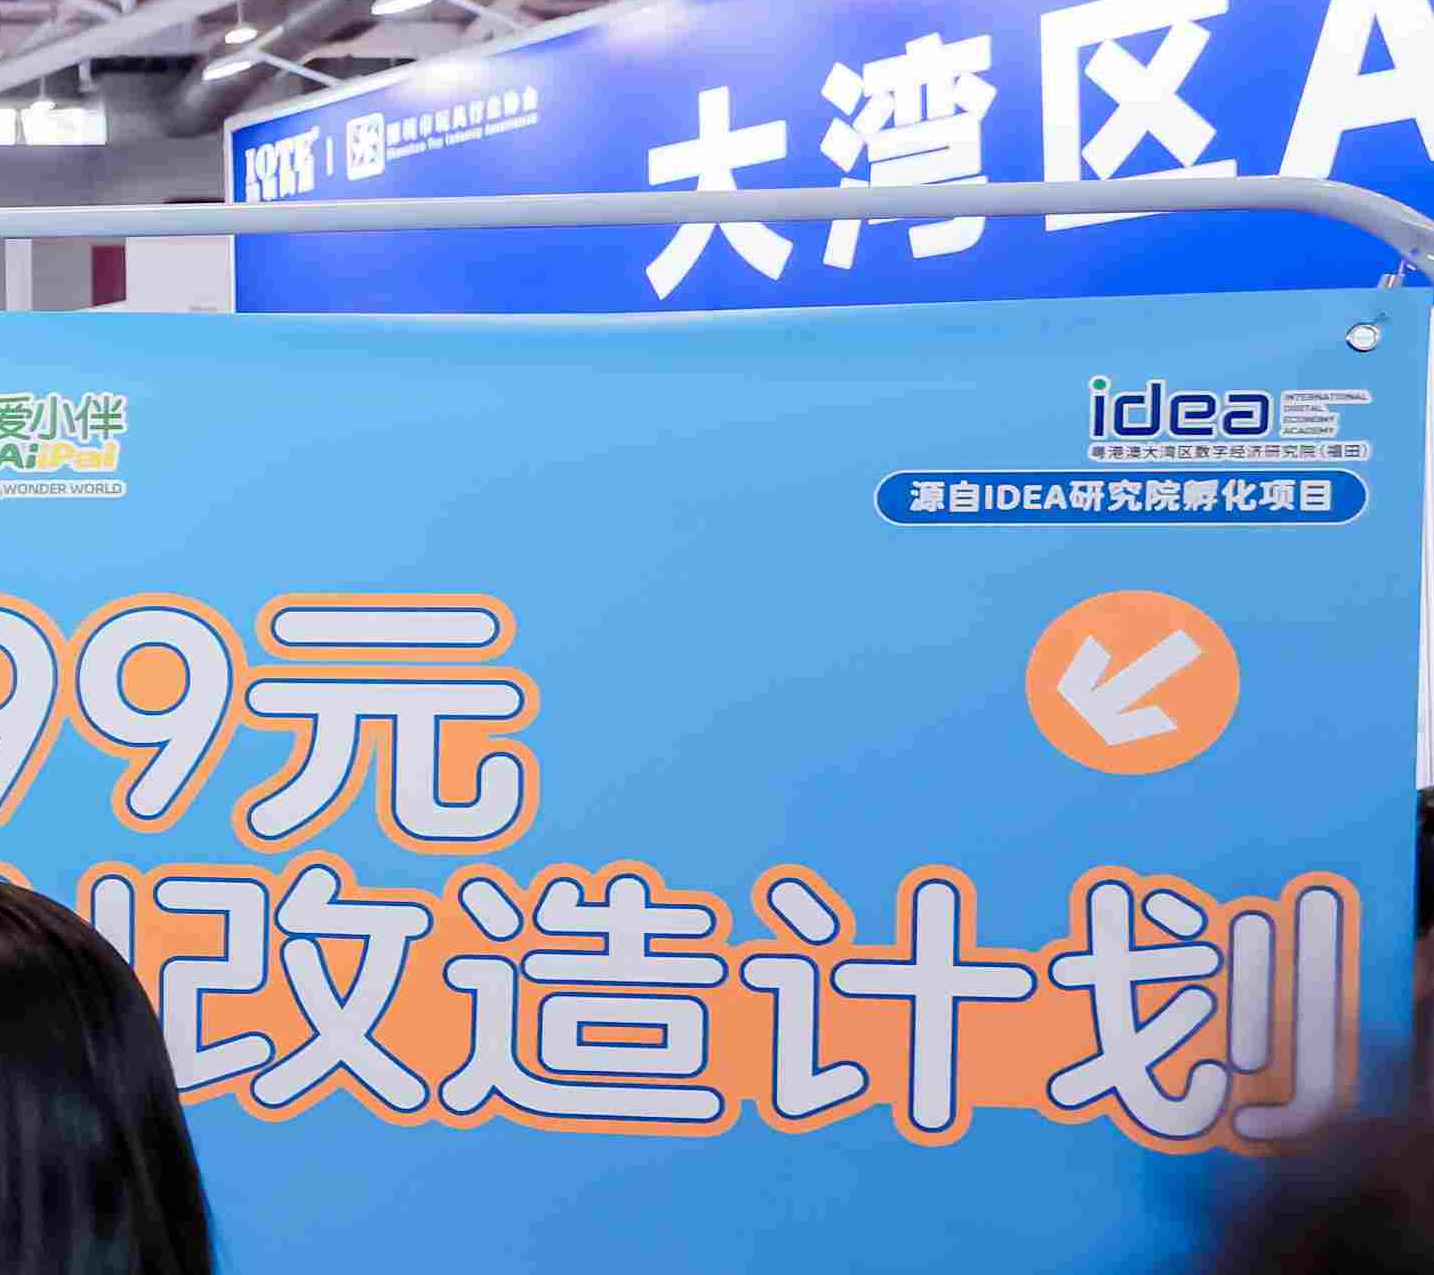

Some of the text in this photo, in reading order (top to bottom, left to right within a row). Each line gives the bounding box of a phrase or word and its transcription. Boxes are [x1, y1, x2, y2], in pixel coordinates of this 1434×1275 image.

[1092, 377, 1270, 437] idea
[68, 483, 122, 495] WORLD
[909, 480, 1332, 513] 源自IDEA研究院孵化项目
